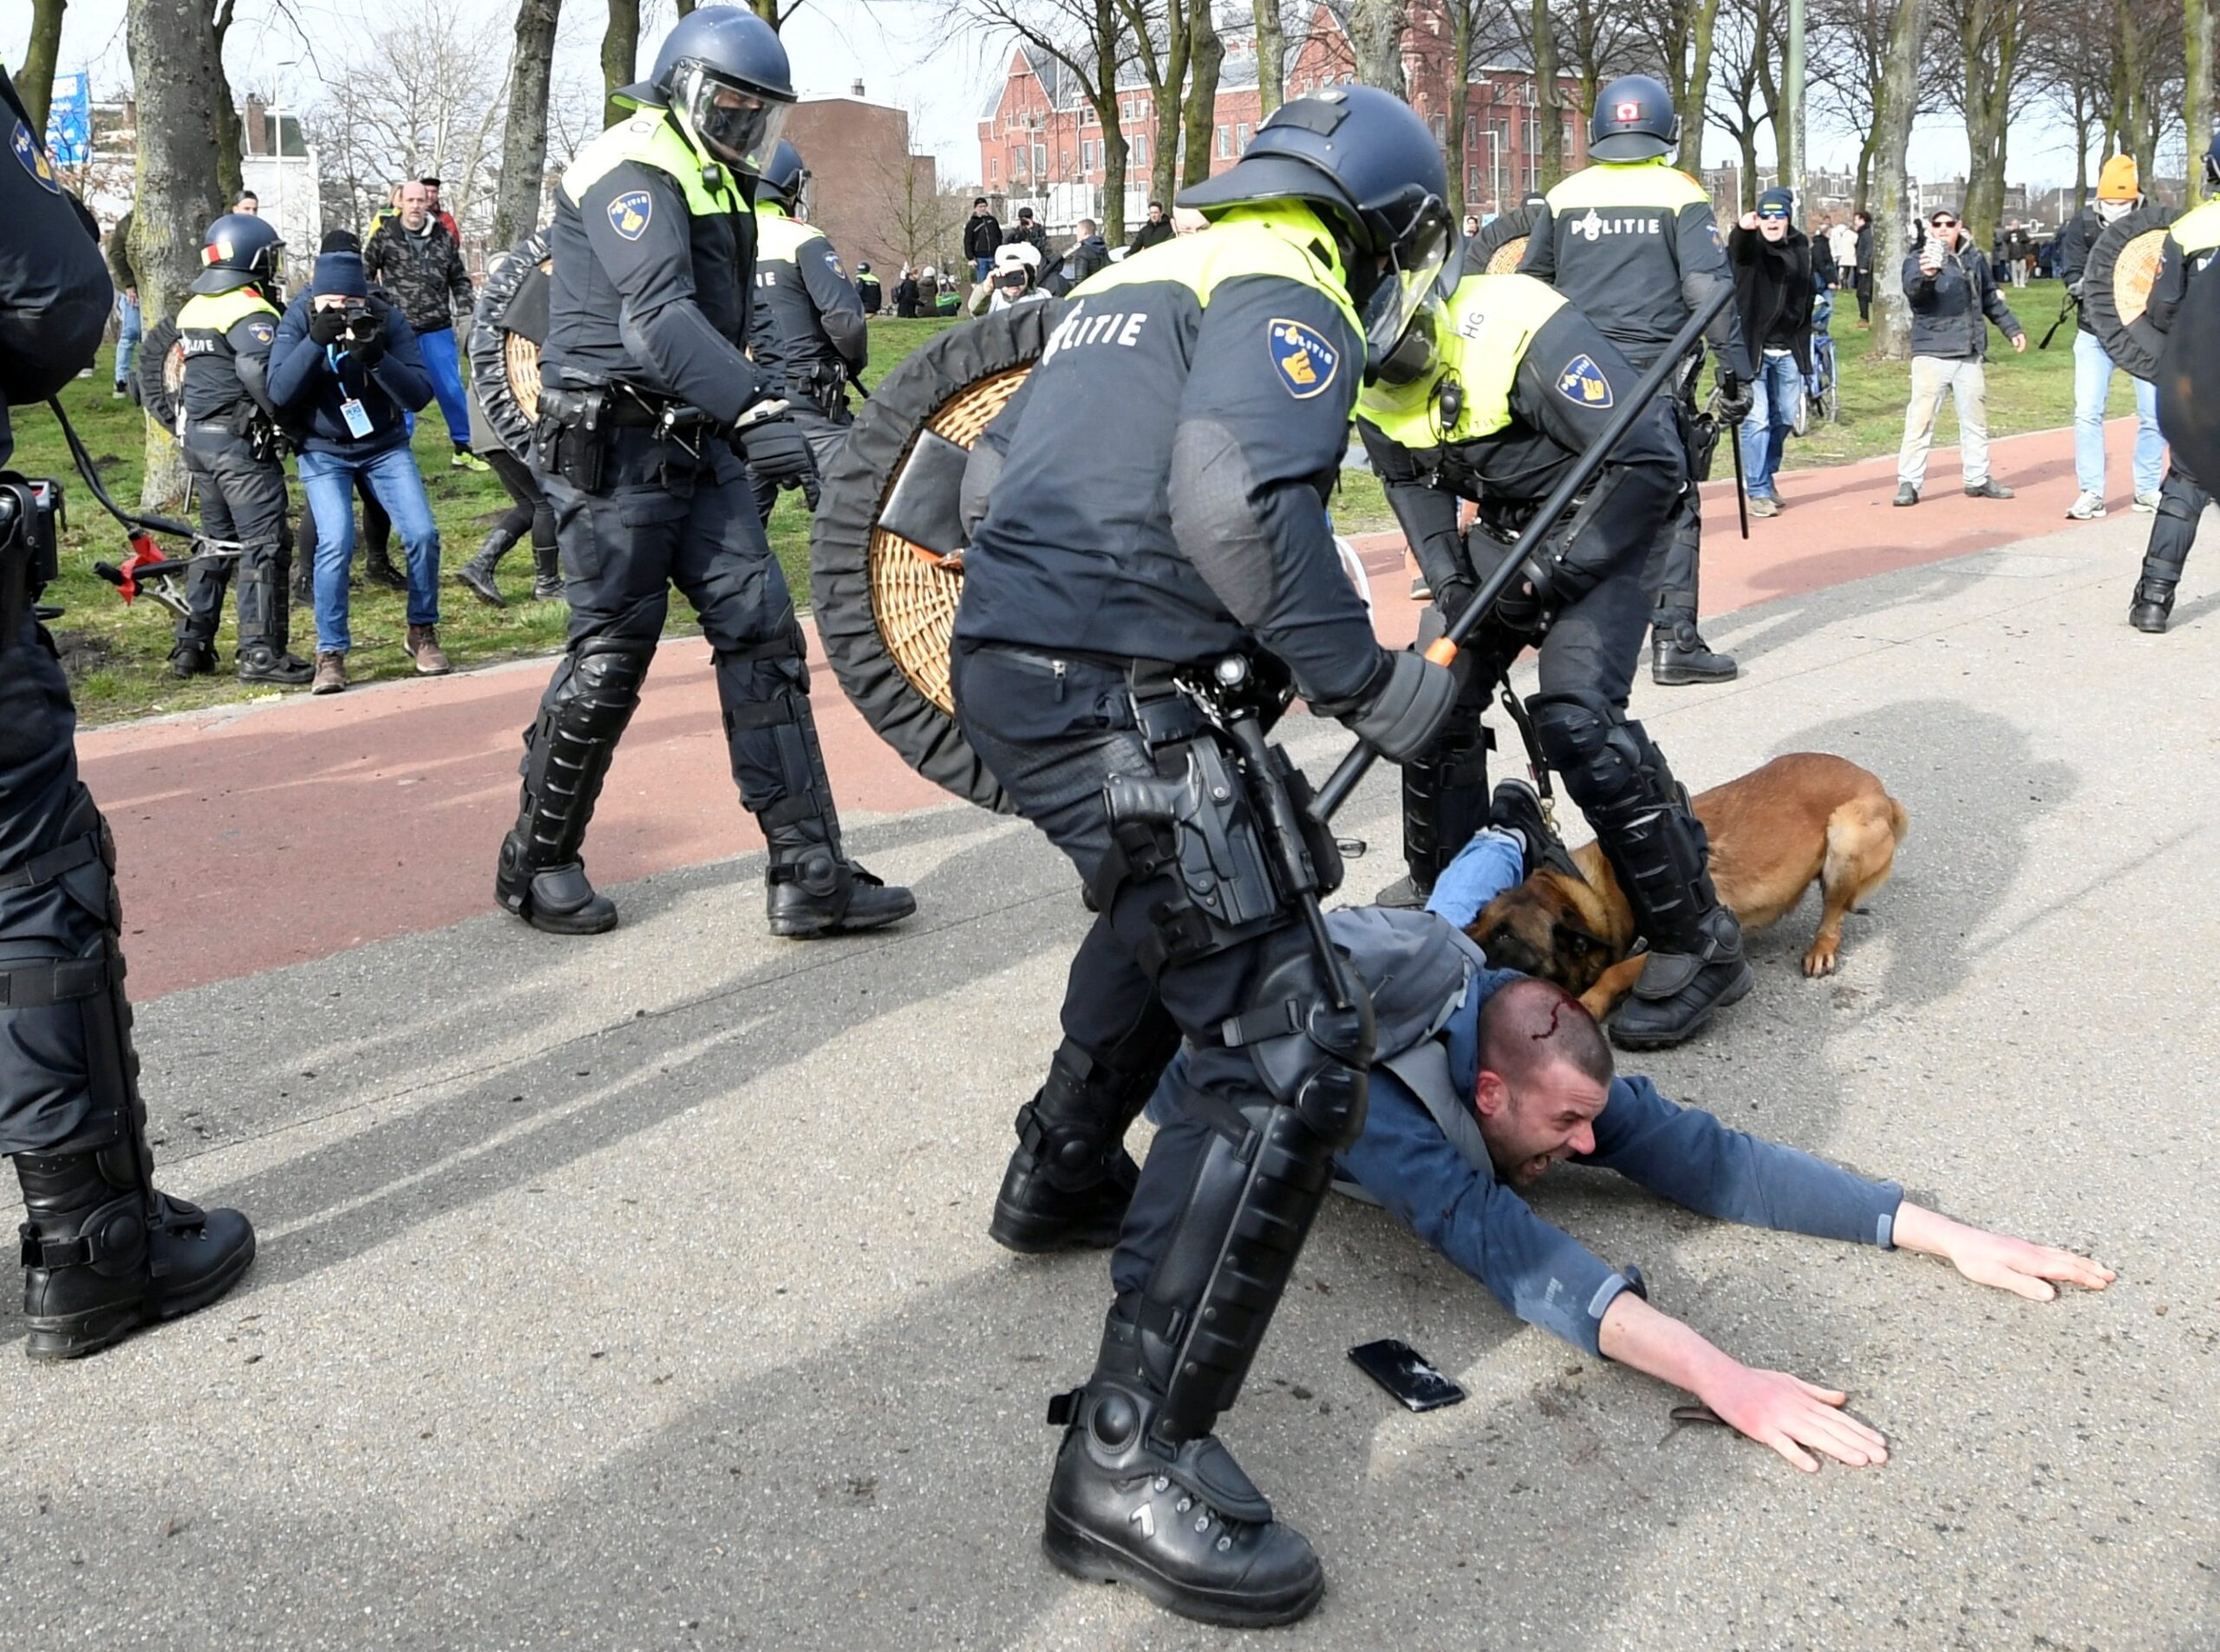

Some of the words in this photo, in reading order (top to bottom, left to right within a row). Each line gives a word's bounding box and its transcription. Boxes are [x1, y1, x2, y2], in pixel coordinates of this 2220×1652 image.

[1570, 208, 1660, 241] POLITIE
[1462, 312, 1485, 339] HG
[1274, 325, 1333, 365] POLITIE
